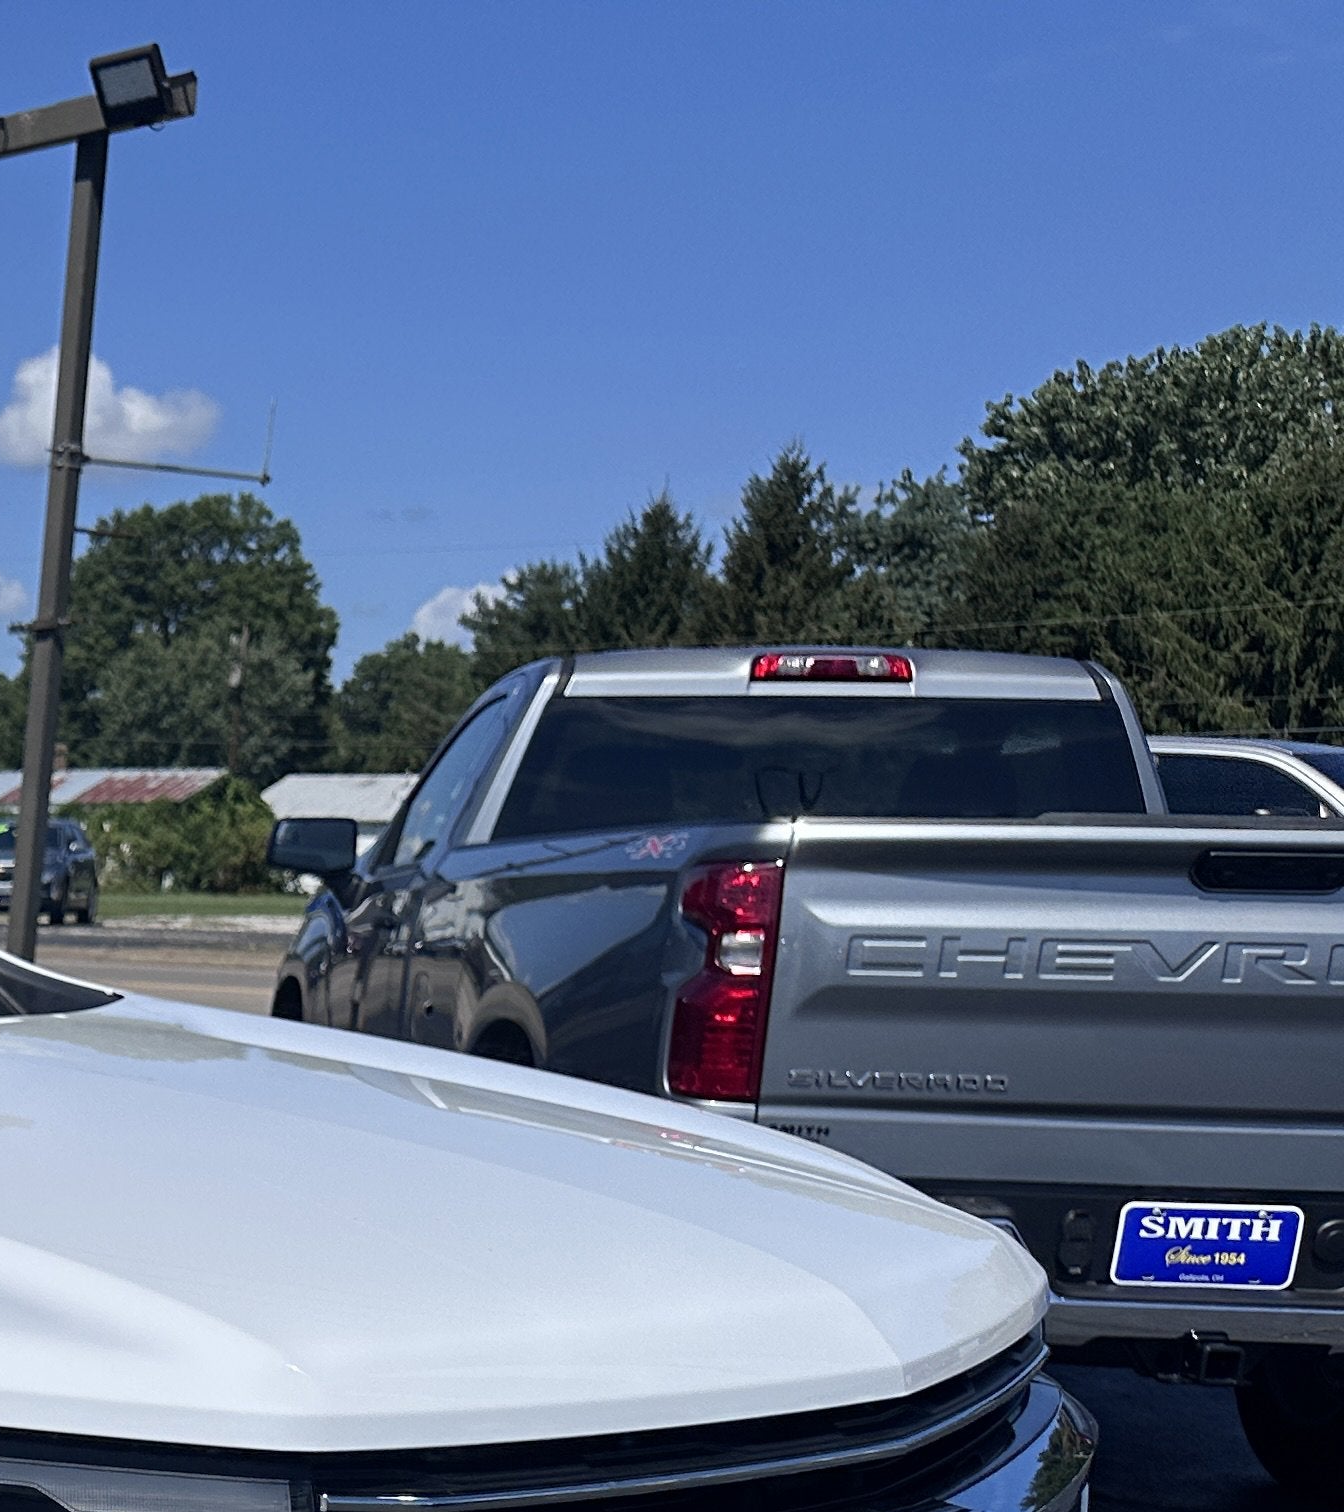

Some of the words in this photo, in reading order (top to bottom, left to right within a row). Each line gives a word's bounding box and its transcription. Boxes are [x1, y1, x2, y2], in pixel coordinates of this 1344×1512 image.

[845, 934, 1344, 986] CHEVR
[788, 1068, 1009, 1093] SILVERADO
[1139, 1215, 1284, 1242] SMITH
[1165, 1244, 1212, 1267] Since
[1213, 1252, 1246, 1266] 1954
